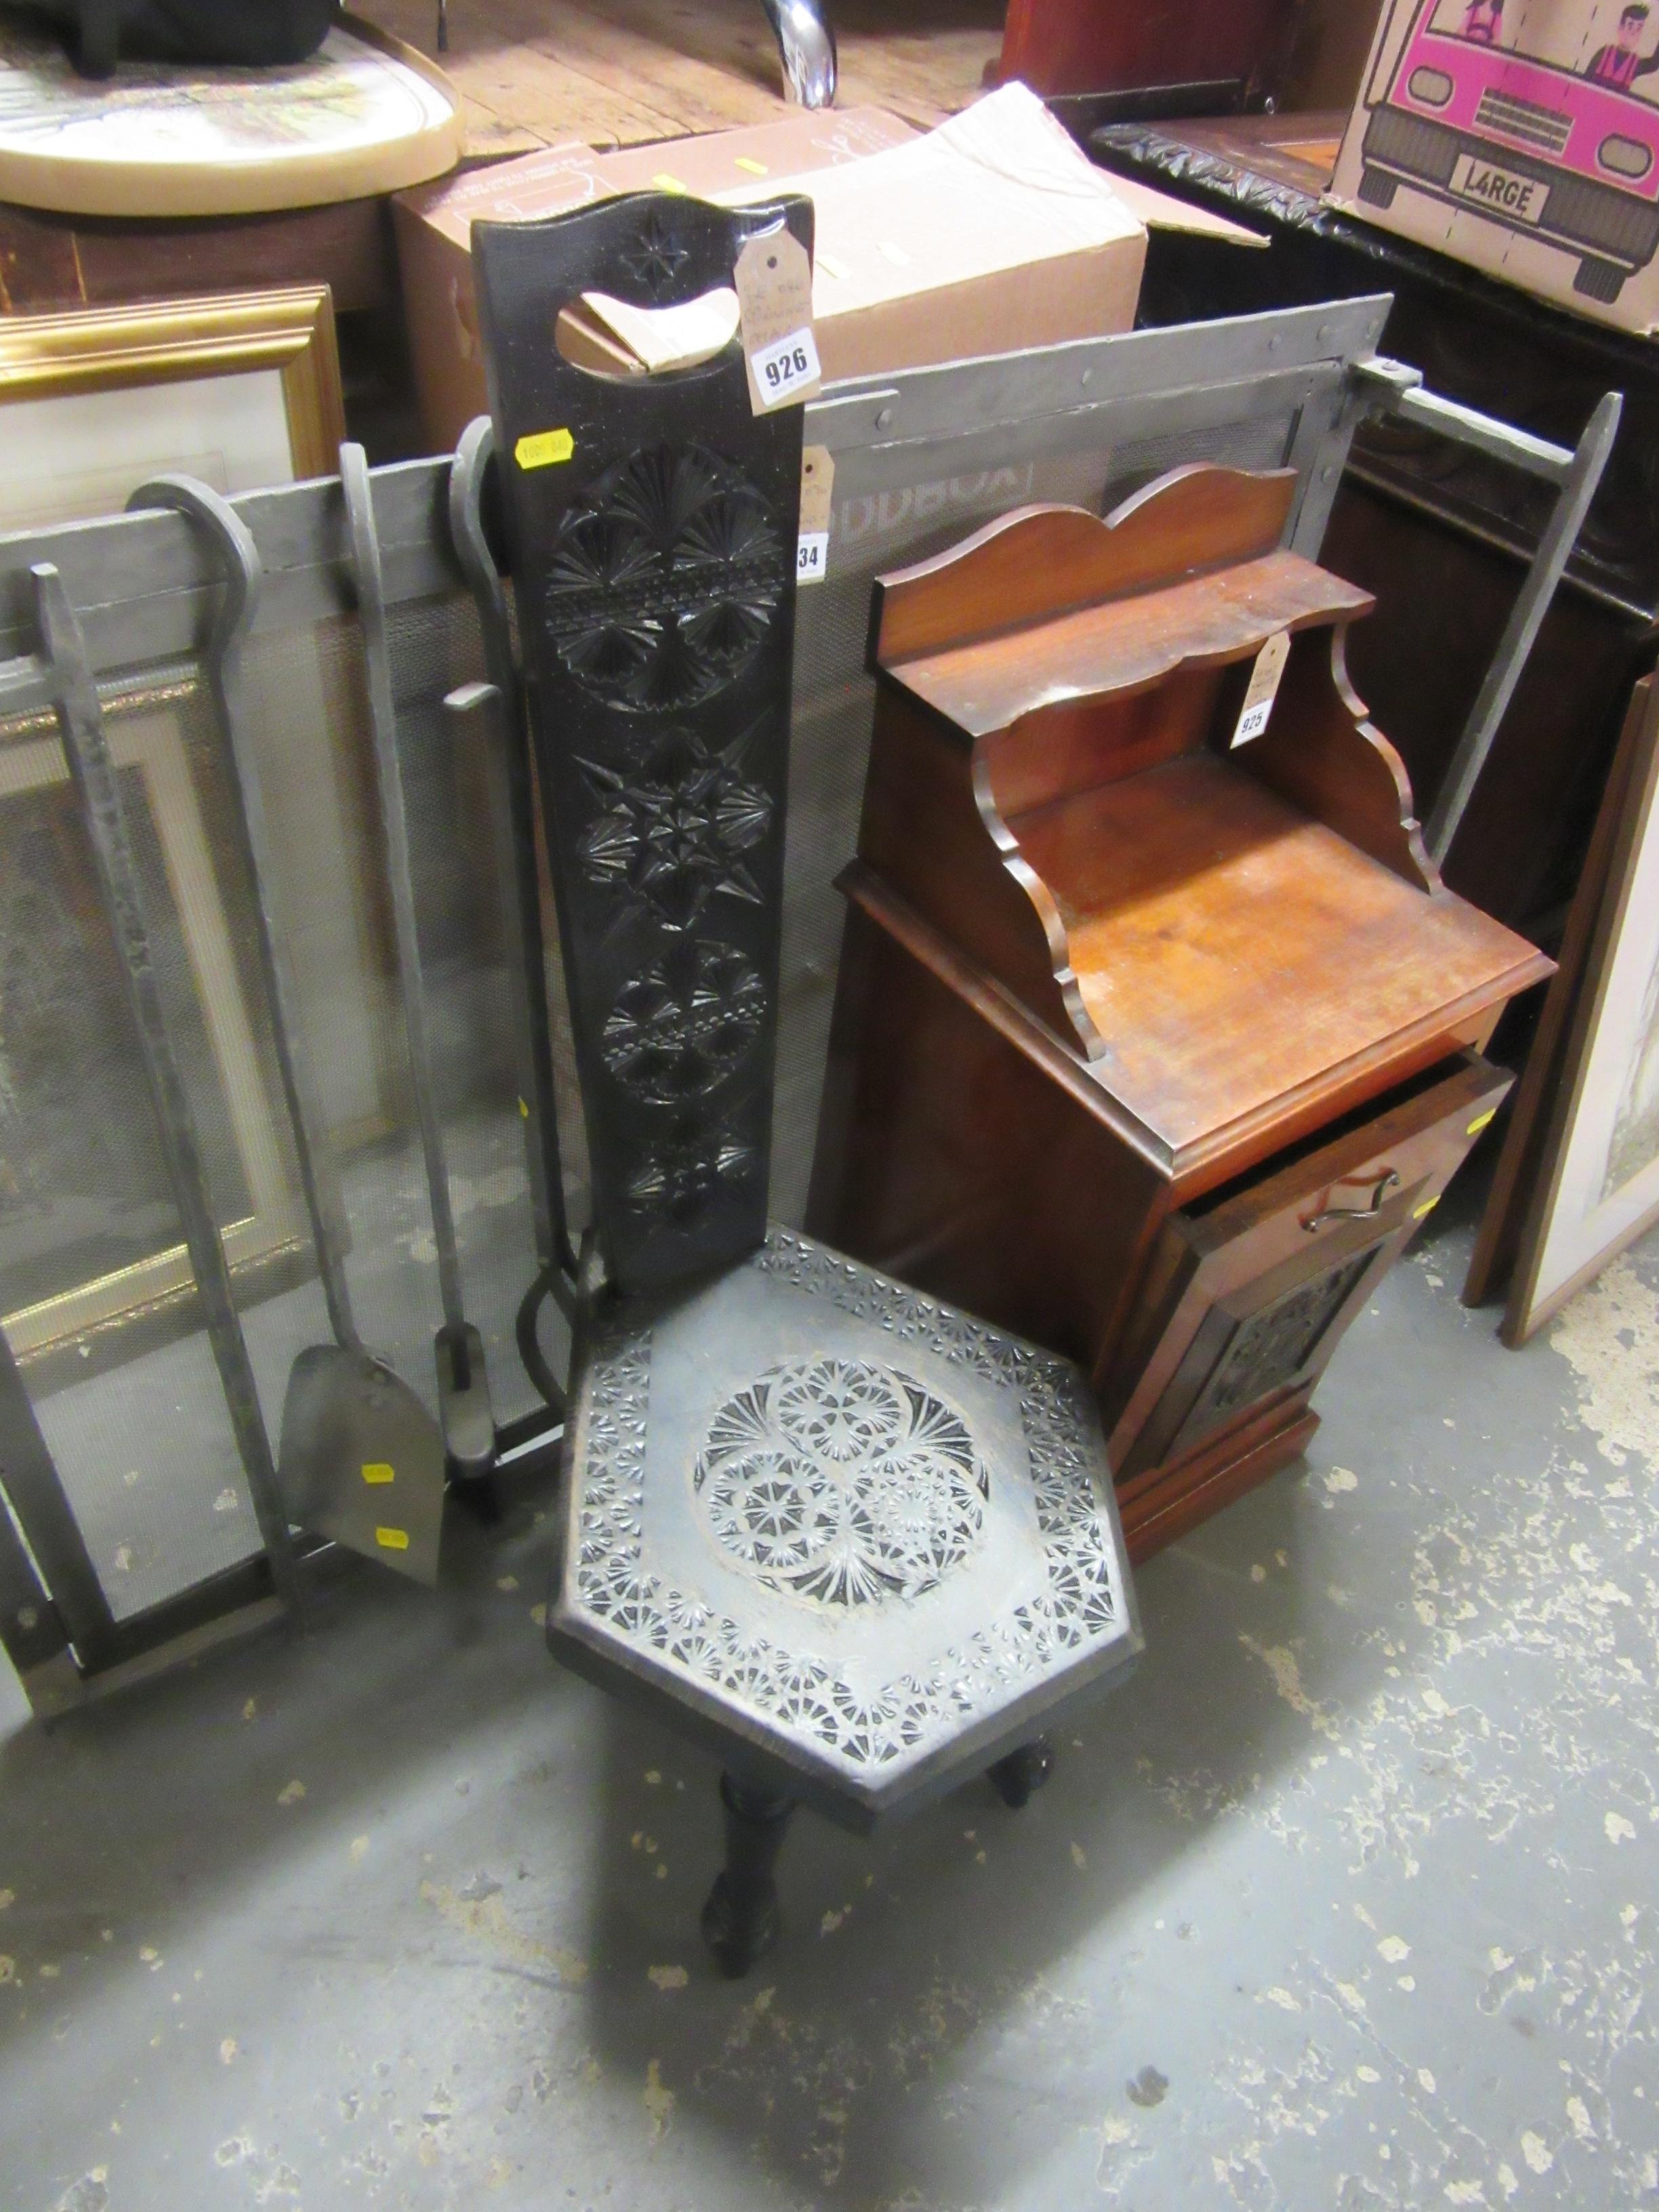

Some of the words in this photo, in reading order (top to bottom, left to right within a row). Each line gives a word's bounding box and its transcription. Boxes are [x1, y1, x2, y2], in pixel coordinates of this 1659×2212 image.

[1463, 165, 1534, 211] L4RGE
[765, 347, 807, 386] 926
[1242, 712, 1263, 734] 925
